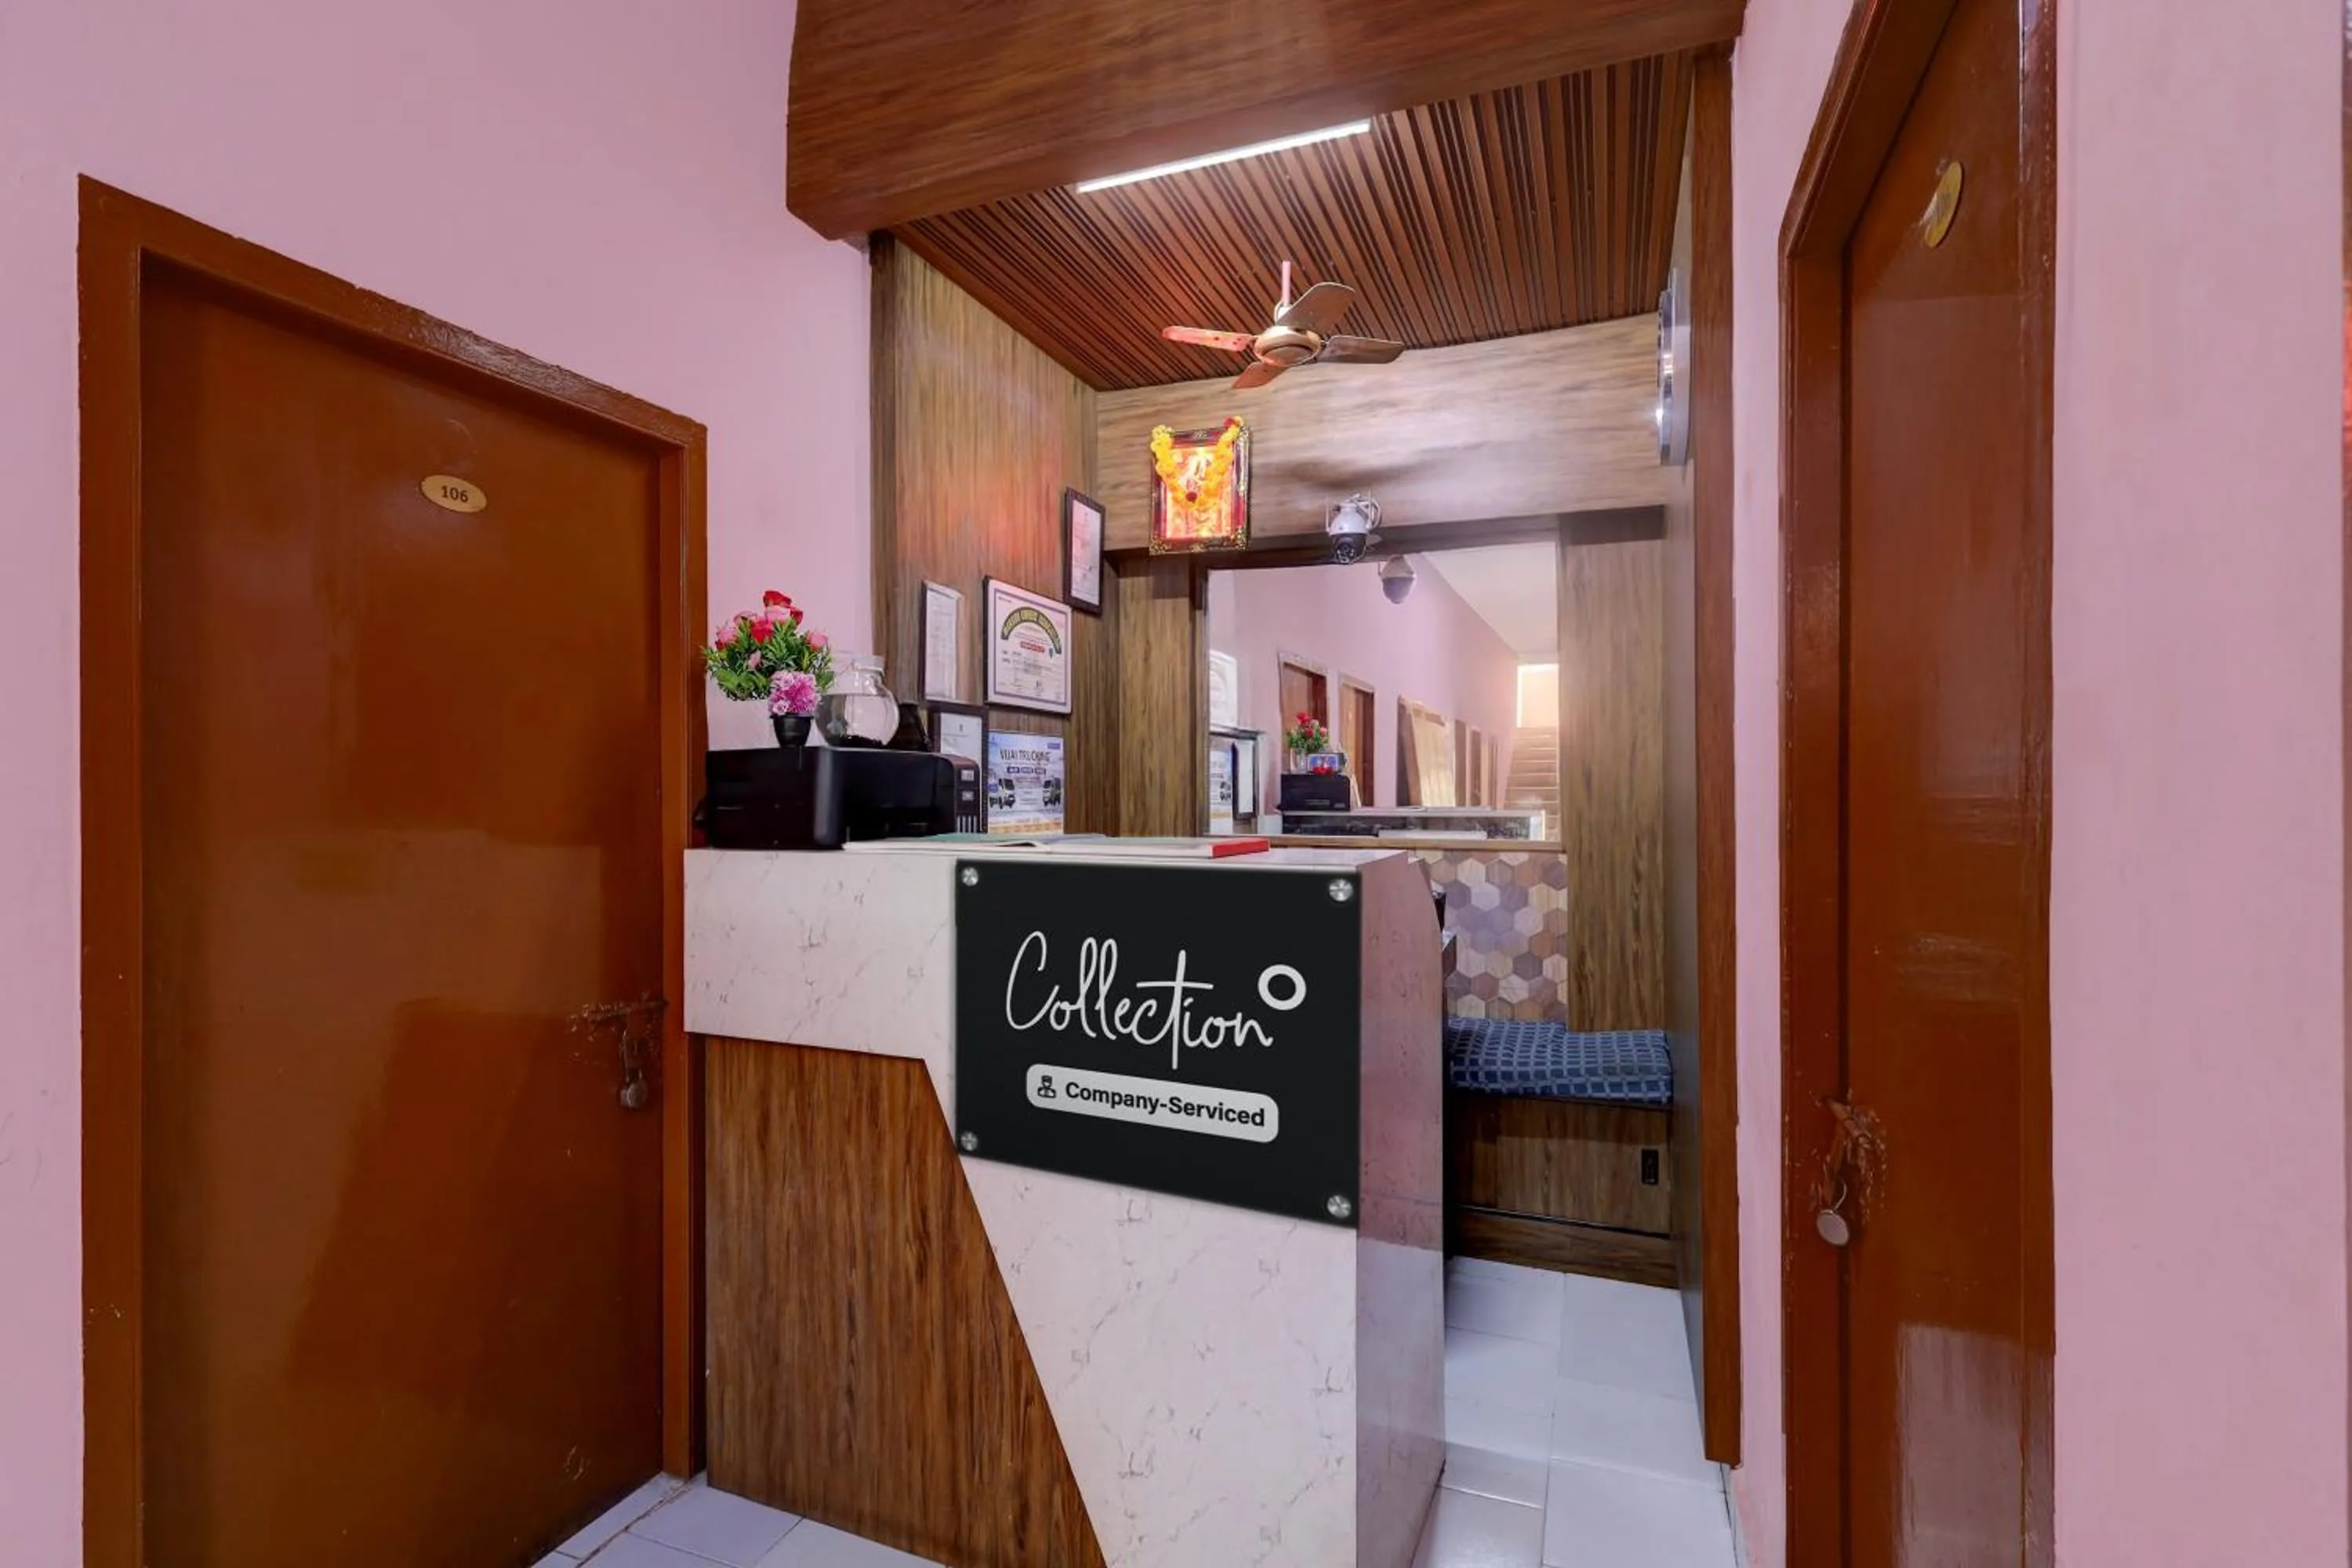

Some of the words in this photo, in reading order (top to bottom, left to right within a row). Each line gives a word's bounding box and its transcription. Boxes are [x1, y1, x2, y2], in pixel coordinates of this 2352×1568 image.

[441, 485, 469, 503] 106
[1006, 931, 1274, 1070] Collection
[1065, 1081, 1265, 1128] Company-Serviced
